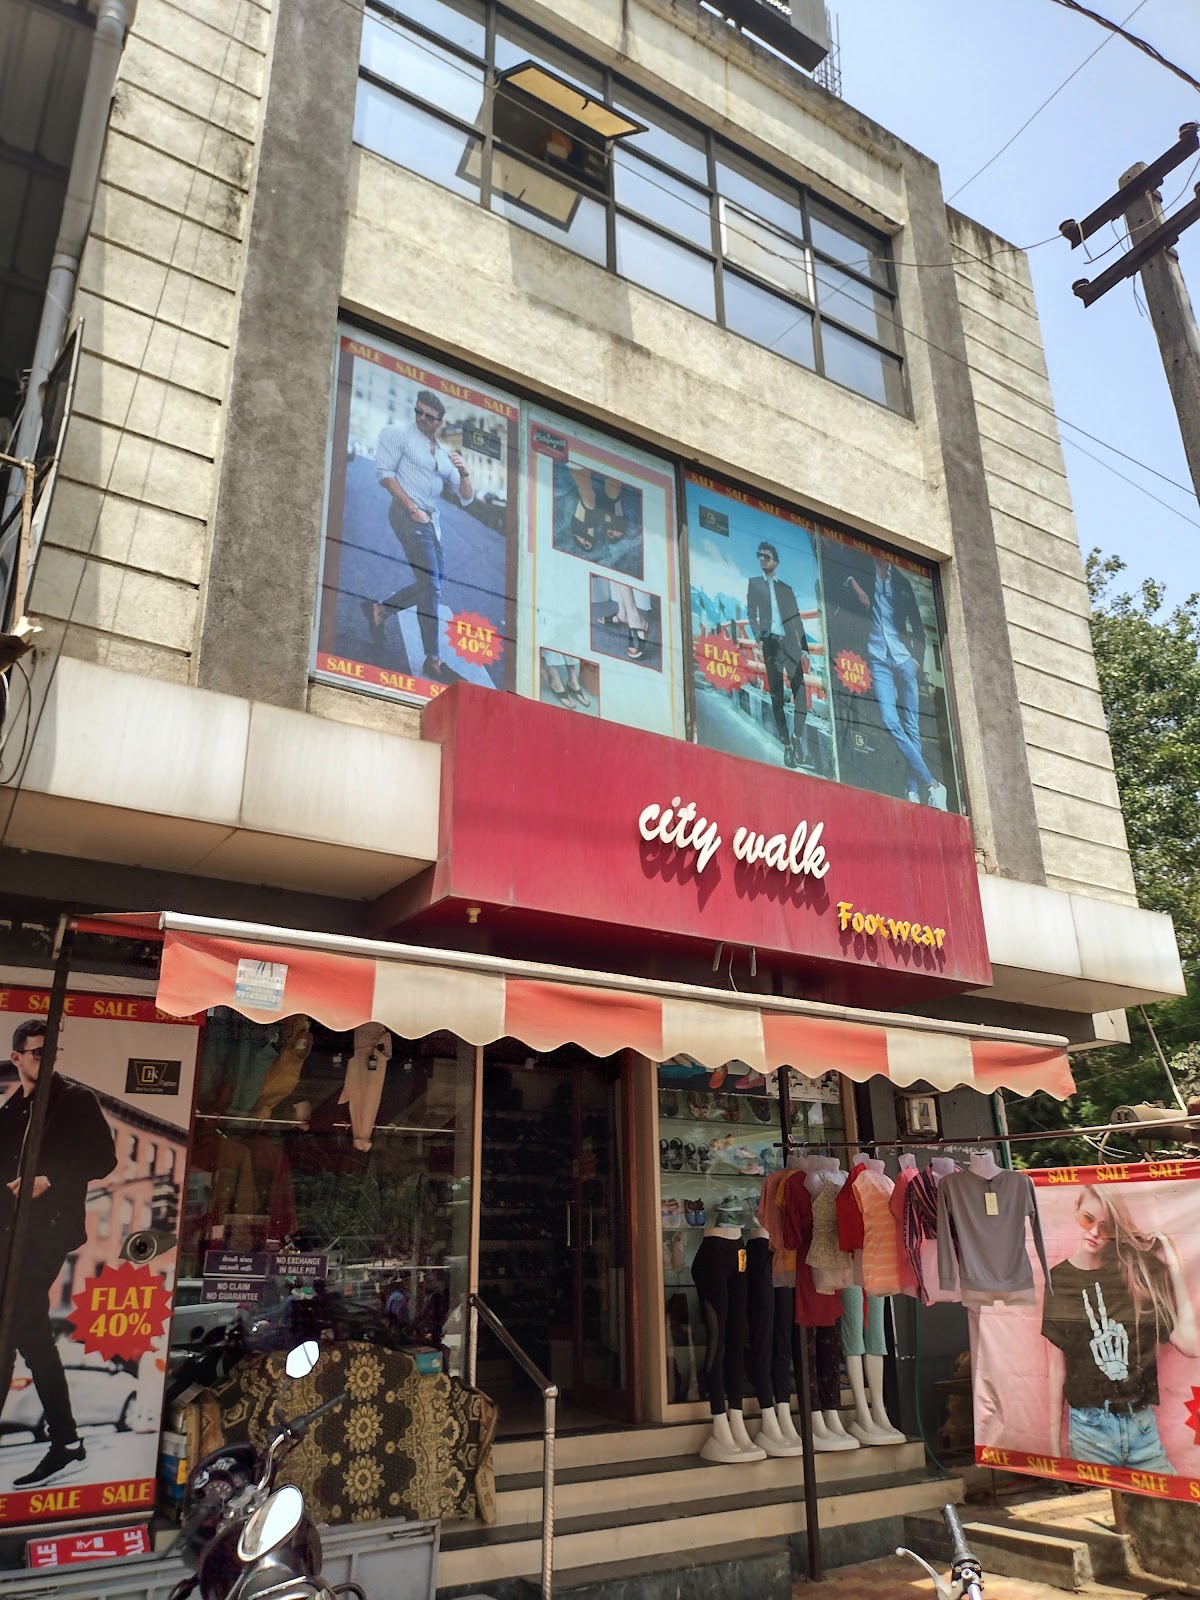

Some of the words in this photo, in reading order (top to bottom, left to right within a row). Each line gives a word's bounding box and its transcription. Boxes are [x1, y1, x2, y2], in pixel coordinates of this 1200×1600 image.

[349, 342, 382, 364] SALE
[395, 362, 427, 384] SALE
[441, 380, 471, 400] SALE
[483, 398, 513, 417] SALE
[692, 473, 715, 489] SALE
[726, 487, 749, 504] SALE
[758, 501, 781, 517] SALE
[823, 527, 843, 543] SALE
[853, 540, 872, 554] SALE
[880, 551, 900, 565] SALE
[457, 620, 494, 643] FLAT
[457, 637, 493, 658] 40%
[704, 643, 739, 666] FLAT
[327, 657, 365, 679] SALE
[379, 671, 416, 692] SALE
[706, 661, 740, 682] 40%
[841, 658, 865, 675] FLAT
[842, 671, 867, 687] 40%
[639, 796, 722, 874] city
[733, 819, 831, 880] walk
[837, 901, 947, 949] Footwear
[28, 994, 75, 1013] SAE
[93, 1000, 138, 1018] SALE
[1048, 1168, 1080, 1183] SALE
[1096, 1165, 1130, 1181] SALE
[1148, 1162, 1186, 1178] SALE
[279, 1266, 287, 1274] IN
[287, 1266, 304, 1274] SALE
[287, 1257, 321, 1265] EXCHANGE
[91, 1286, 158, 1311] FLAT
[206, 1292, 217, 1300] NO
[218, 1292, 259, 1301] GUARANTEE
[89, 1311, 152, 1338] 40%
[981, 1448, 1011, 1466] SALE
[1027, 1456, 1060, 1475] SALE
[1077, 1463, 1111, 1484] SALE
[1131, 1472, 1169, 1494] SALE
[29, 1490, 81, 1513] SALE
[102, 1482, 152, 1505] SALE
